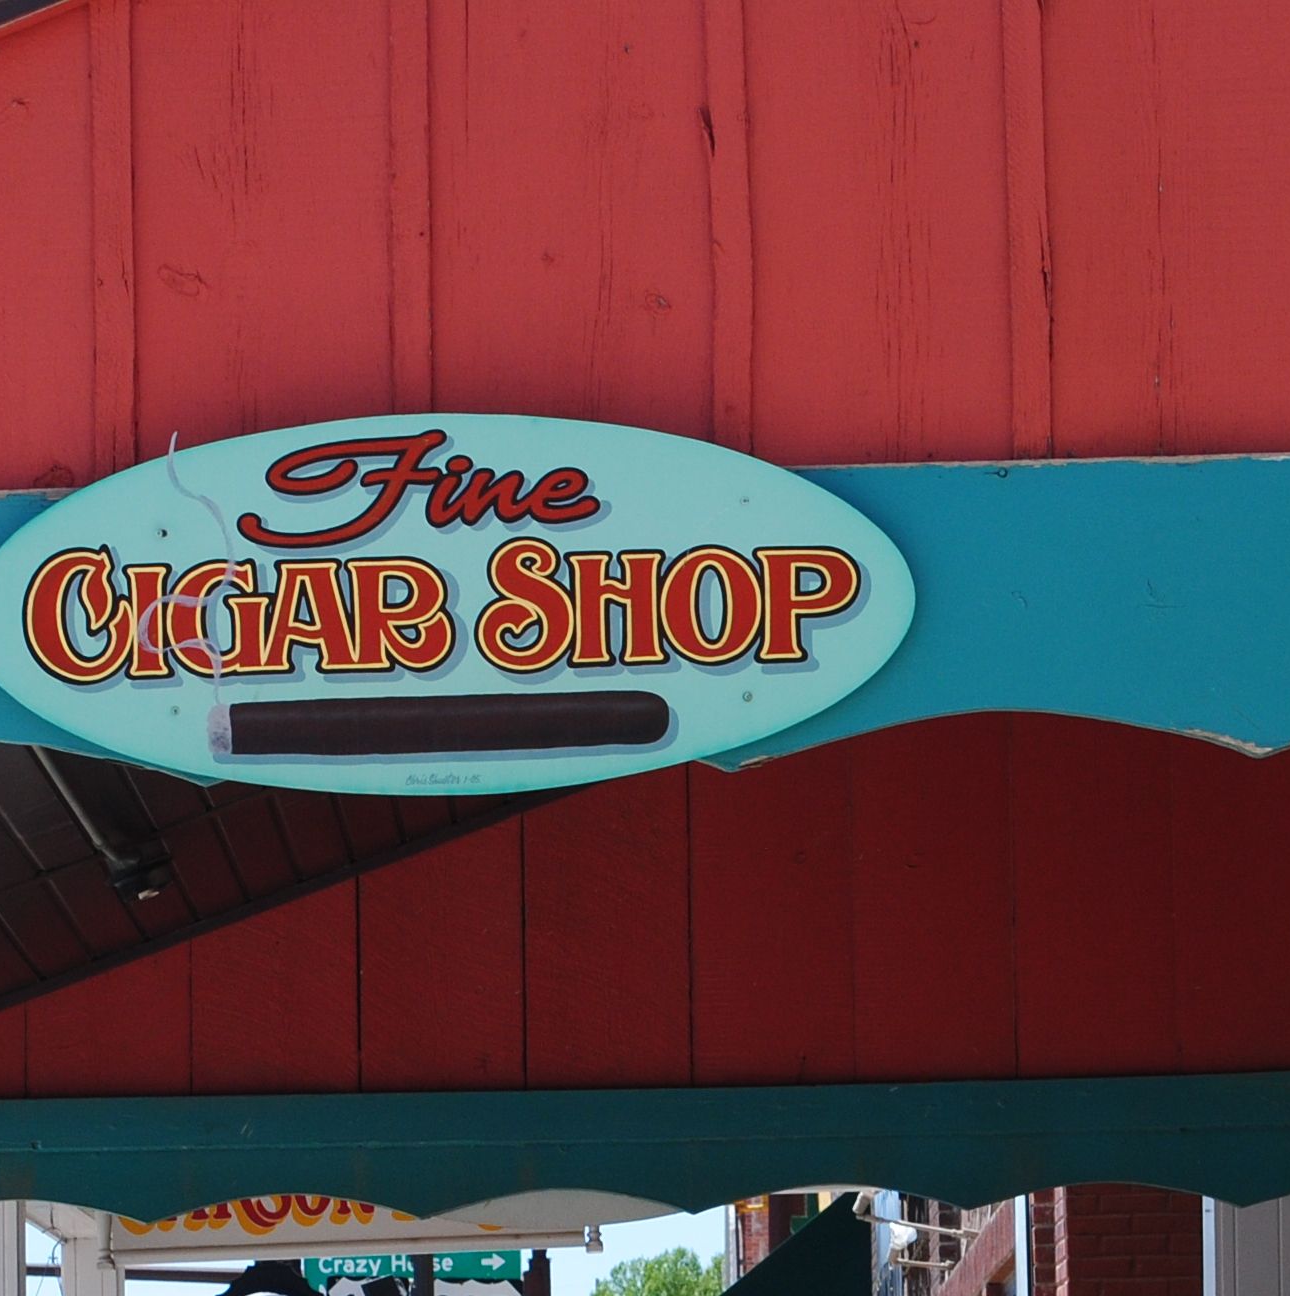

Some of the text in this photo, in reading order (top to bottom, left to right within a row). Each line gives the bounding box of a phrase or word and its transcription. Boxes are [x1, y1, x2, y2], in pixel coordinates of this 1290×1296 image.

[237, 429, 600, 548] Fine
[23, 538, 859, 682] CIGAR SHOP
[318, 1255, 454, 1274] Crazy Hose
